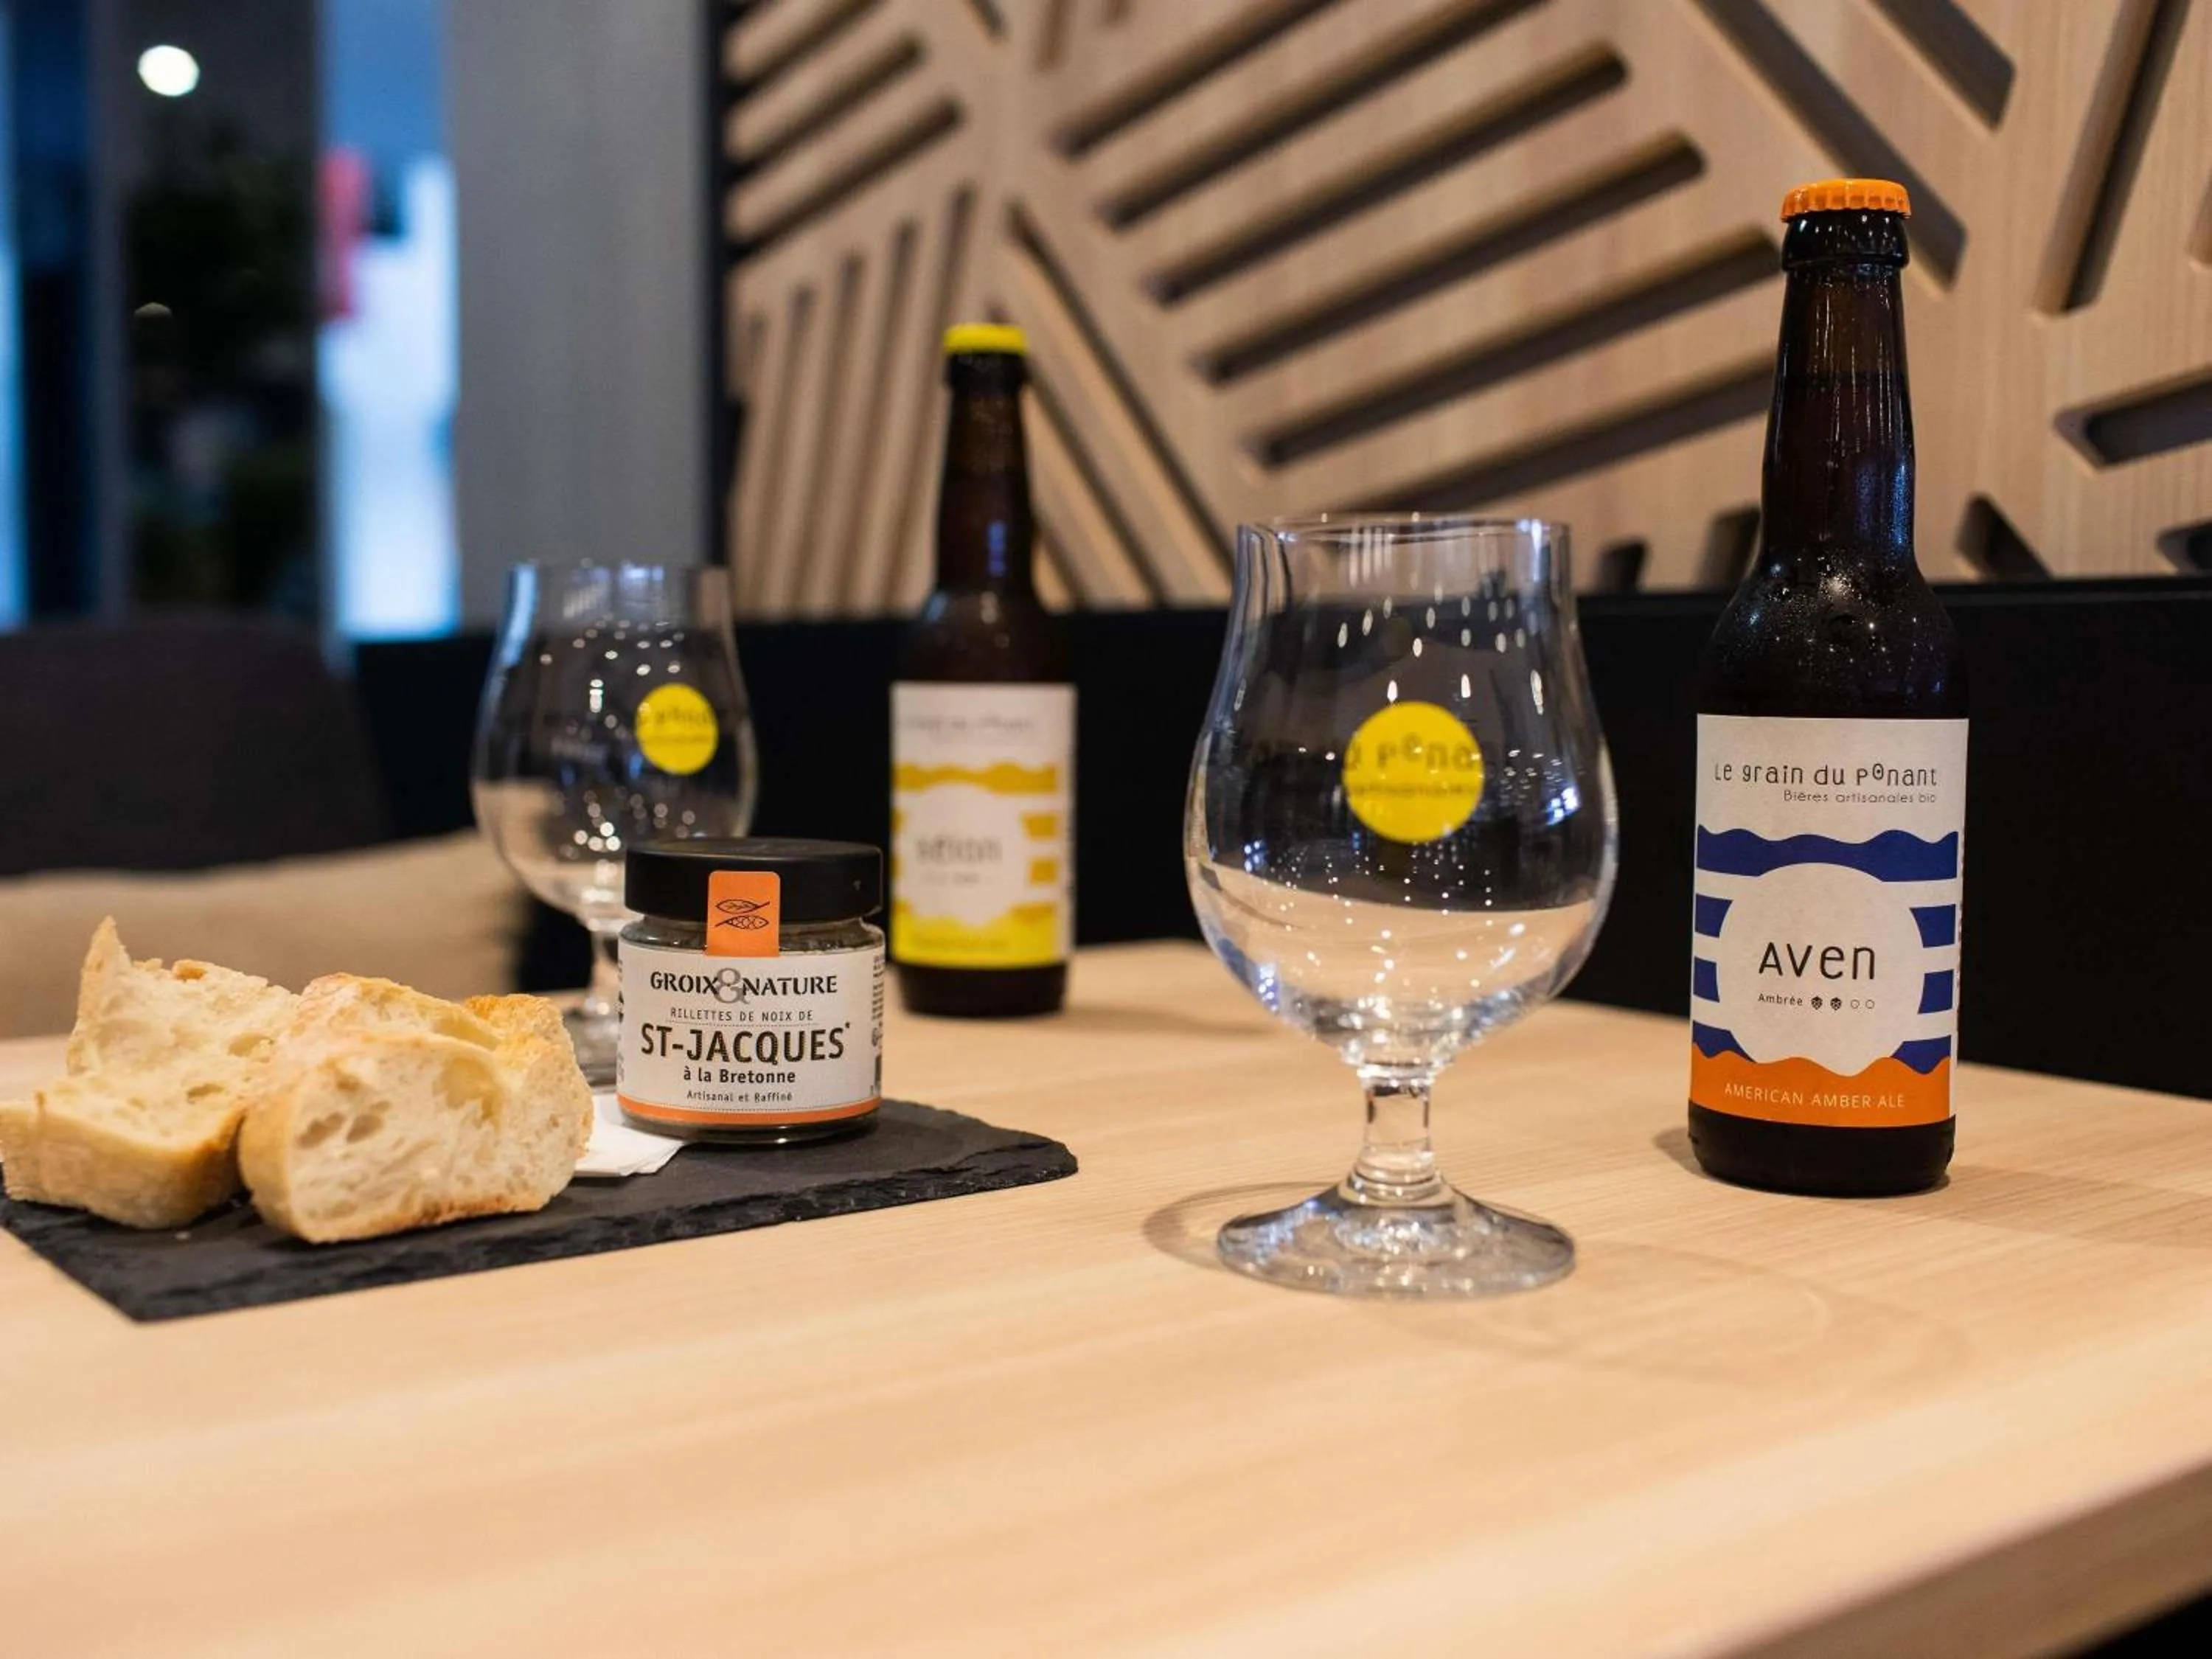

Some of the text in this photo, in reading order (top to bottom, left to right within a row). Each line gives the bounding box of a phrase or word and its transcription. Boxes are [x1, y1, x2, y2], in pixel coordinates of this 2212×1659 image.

[1714, 762, 1937, 787] Le grain du Ponant
[1783, 789, 1936, 804] Bières artisanales bio
[650, 971, 720, 996] GROIX
[742, 975, 838, 996] NATURE
[1757, 992, 1804, 1006] Ambrée
[669, 1006, 813, 1023] RILLETTES DE NOIX DE
[683, 1066, 797, 1084] à la Bretonne
[686, 1089, 793, 1104] Artisanal et Raffiné
[1724, 1082, 1905, 1109] AMERICAN AMBER ALE
